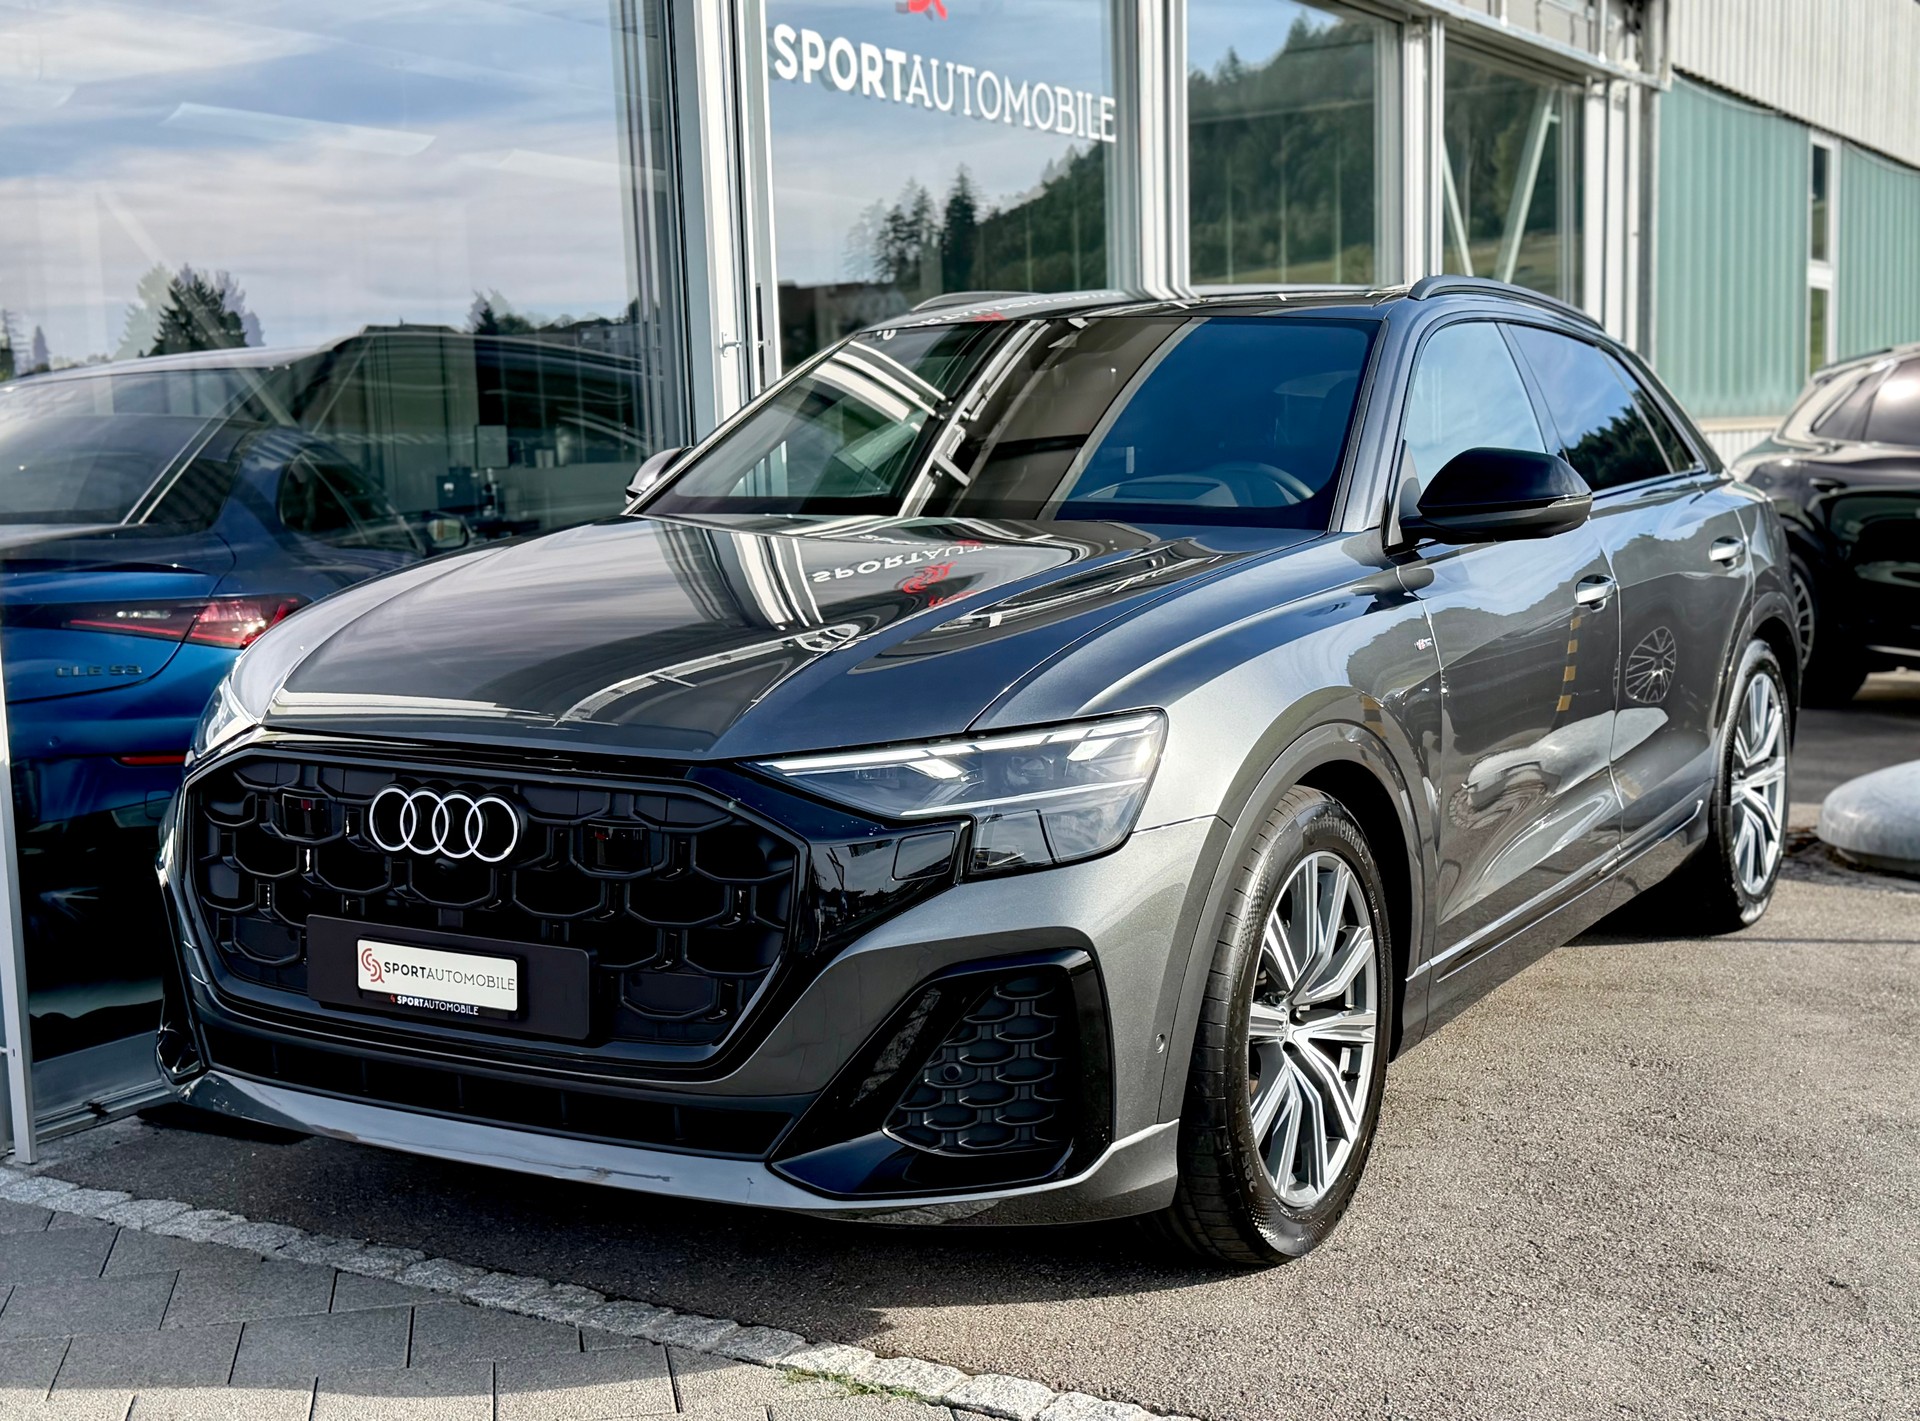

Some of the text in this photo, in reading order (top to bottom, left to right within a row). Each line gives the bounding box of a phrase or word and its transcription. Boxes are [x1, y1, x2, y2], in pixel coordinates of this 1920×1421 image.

[774, 24, 1117, 143] SPORTAUTOMOBILE
[56, 665, 103, 677] CLE
[384, 961, 515, 991] SPORTAUTOMOBILE
[397, 995, 479, 1015] SPORTAUTOMOBILE
